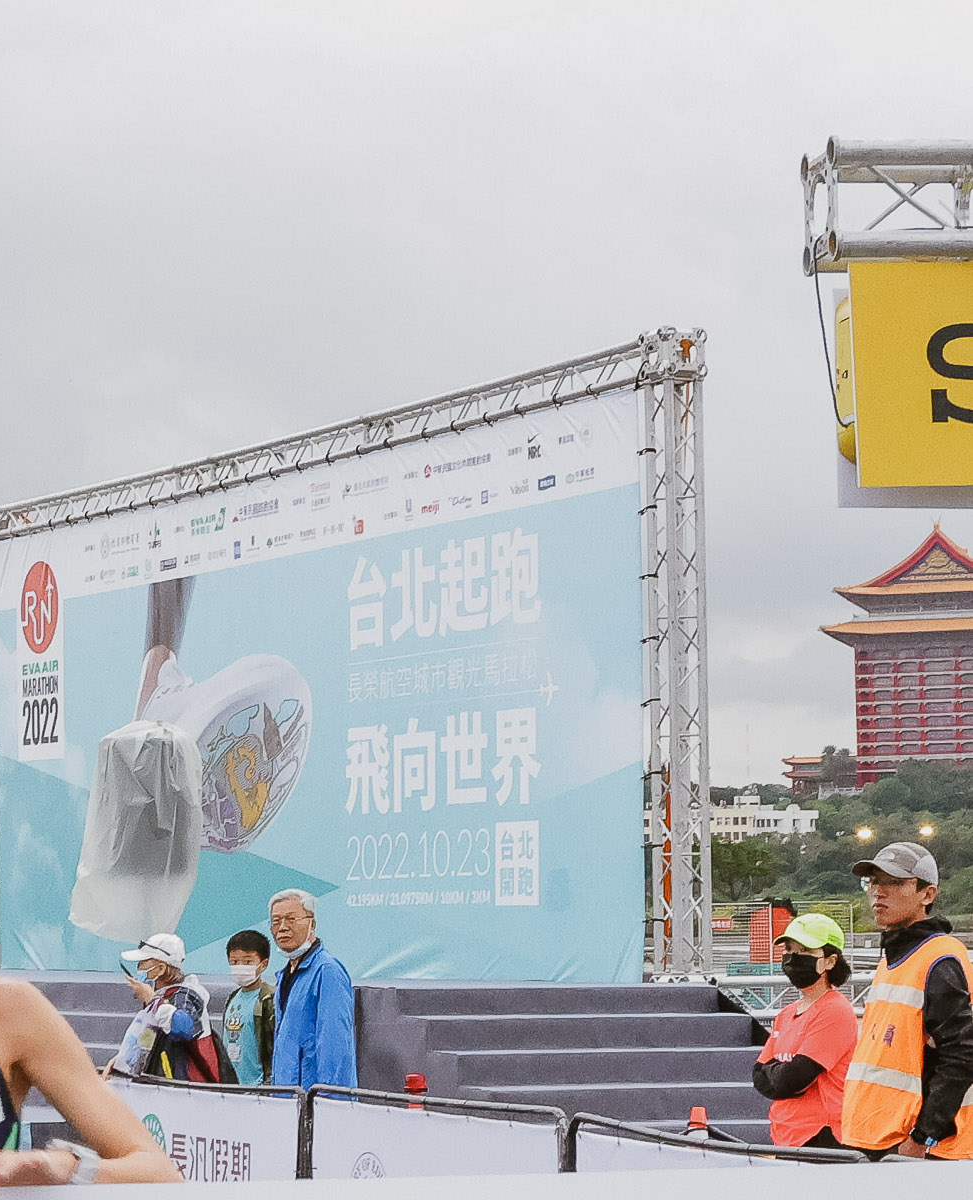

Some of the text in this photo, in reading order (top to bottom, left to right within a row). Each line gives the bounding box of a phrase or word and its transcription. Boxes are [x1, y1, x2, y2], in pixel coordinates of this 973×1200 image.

[421, 503, 440, 515] meiji
[347, 527, 542, 651] 台北起跑
[22, 675, 59, 698] MARATHON
[22, 697, 59, 746] 2022
[345, 706, 542, 816] 飛向世界
[346, 828, 491, 881] 2022.10.23
[500, 830, 534, 862] 台北
[500, 866, 534, 897] 開跑
